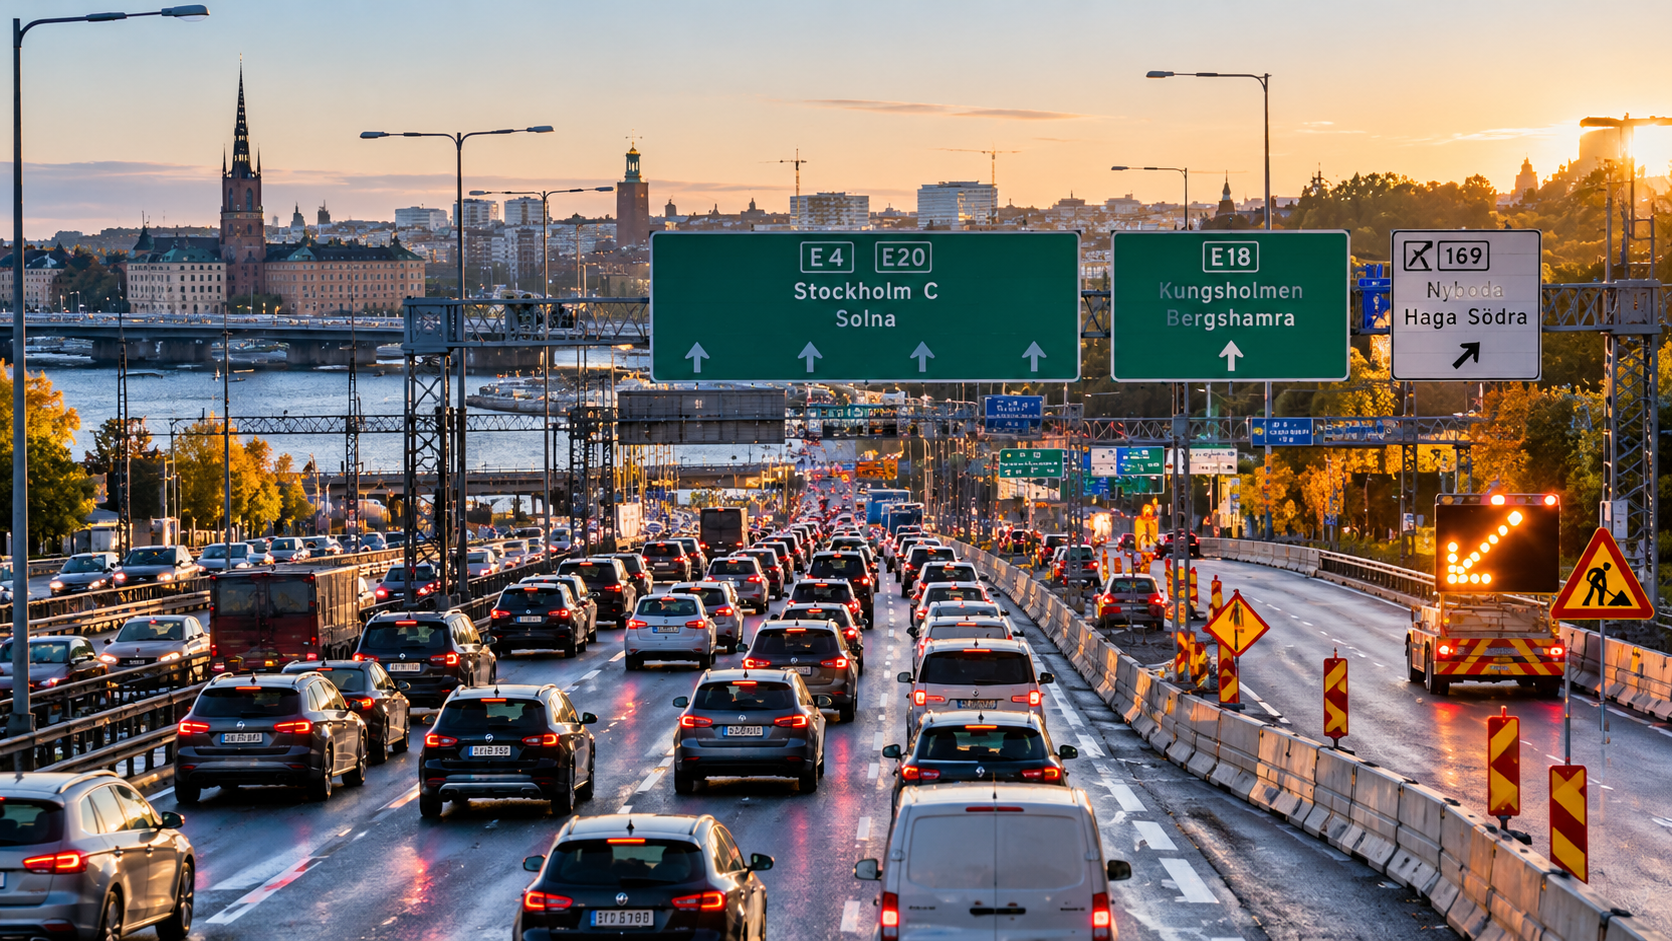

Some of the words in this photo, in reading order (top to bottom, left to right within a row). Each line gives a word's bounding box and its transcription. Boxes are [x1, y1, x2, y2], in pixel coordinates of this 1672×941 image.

[882, 248, 926, 267] E20
[1211, 247, 1251, 266] E18
[1446, 247, 1482, 264] 169
[794, 281, 911, 300] Stockholm
[924, 282, 939, 300] C
[1159, 281, 1303, 304] Kungsholmen
[1427, 281, 1504, 302] Nyboda
[836, 309, 896, 327] Solna
[1166, 308, 1295, 331] Bergshamra
[1405, 308, 1457, 330] Haga
[1468, 307, 1527, 325] Södra
